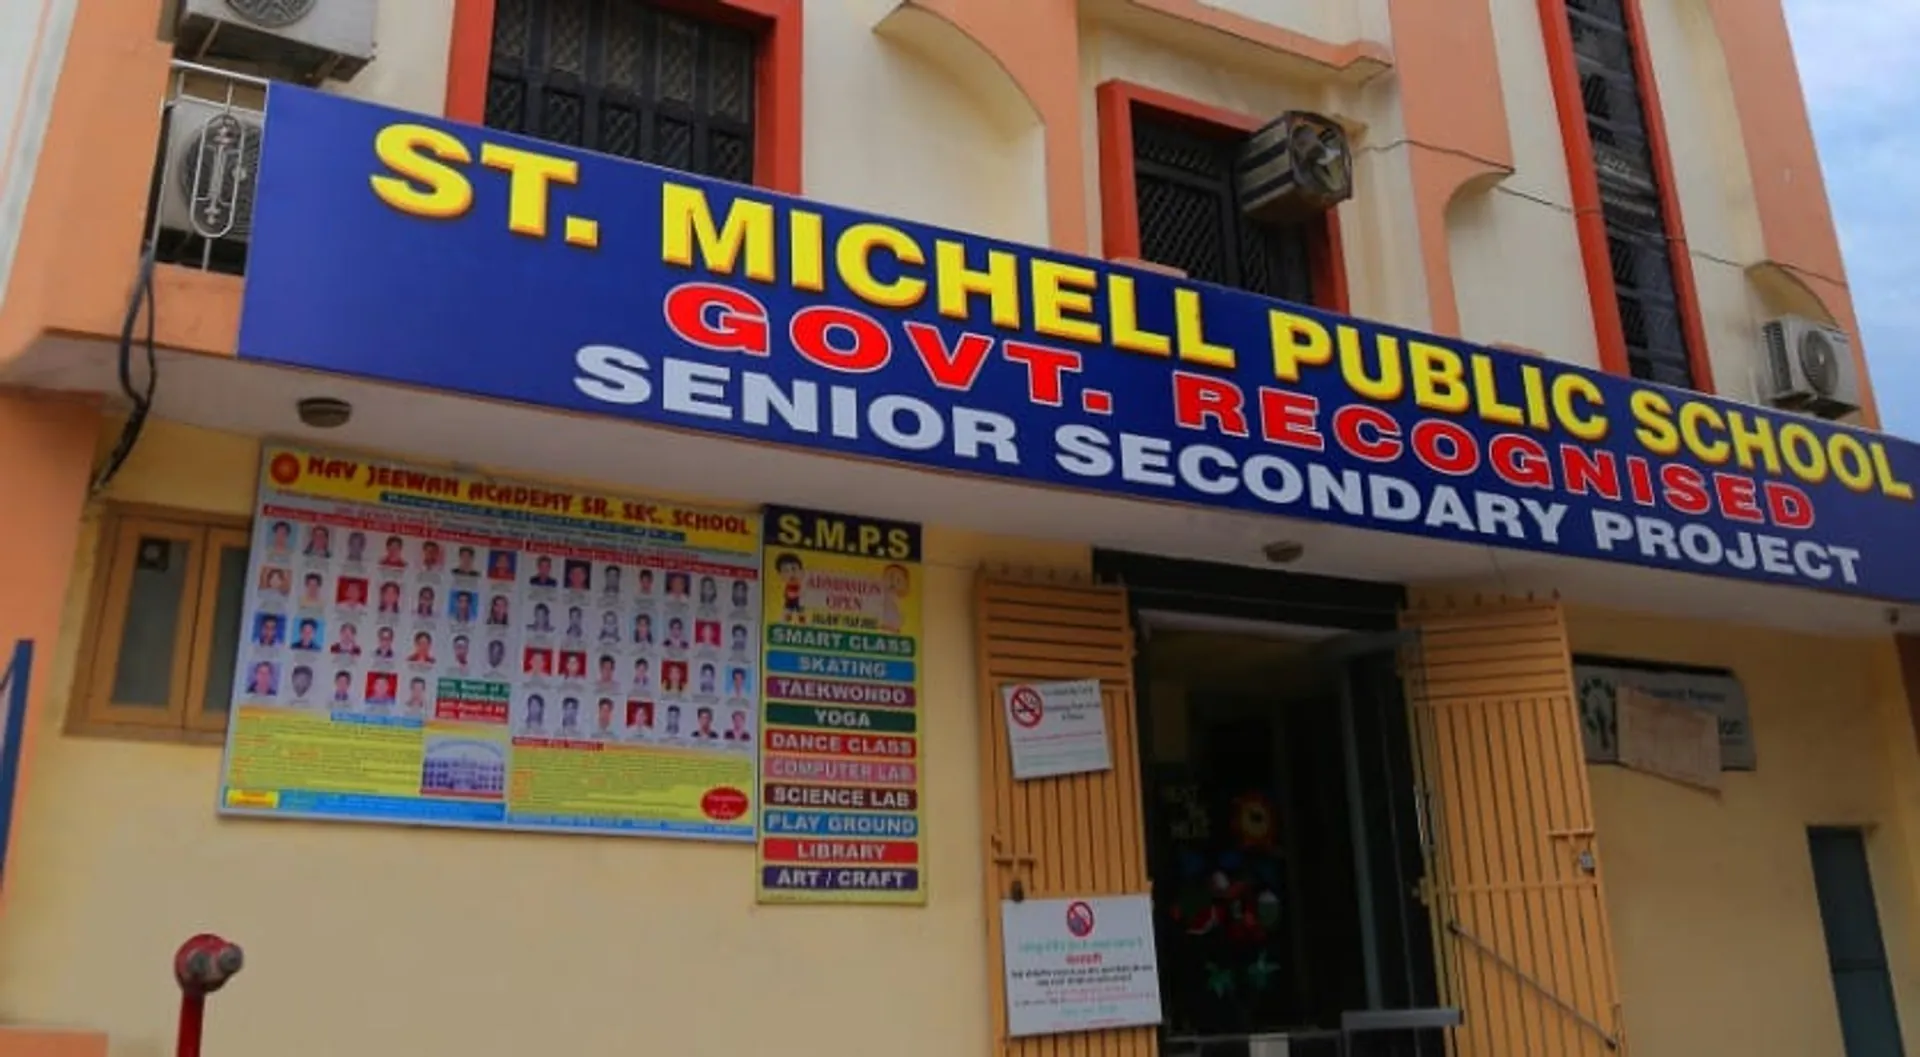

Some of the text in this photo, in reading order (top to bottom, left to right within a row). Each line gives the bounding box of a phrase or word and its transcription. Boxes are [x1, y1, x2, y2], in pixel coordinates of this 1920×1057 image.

[369, 123, 1914, 500] ST. MICHELL PUBLIC SCHOOL
[663, 282, 1816, 529] GOVT. RECOGNISED
[573, 344, 1860, 584] SENIOR SECONDARY PROJECT
[307, 455, 359, 480] NAV
[366, 465, 460, 497] JEEWAN
[468, 481, 573, 513] ACADEMY
[580, 495, 615, 518] SR.
[622, 503, 663, 525] SEC.
[671, 509, 751, 536] SCHOOL
[777, 513, 911, 560] S.M.P.S
[772, 627, 912, 653] SMART CLASS
[799, 655, 888, 678] SKATING
[778, 679, 907, 704] TAEKWONDO
[815, 709, 871, 728] YOGA
[771, 732, 912, 754] DANCE CLASS
[771, 758, 912, 781] COMPUTER LAB
[773, 785, 910, 807] SCIENCE LAB
[767, 811, 823, 830] PLAY
[828, 814, 915, 834] GROUND
[797, 842, 887, 860] LIBRARY
[776, 869, 821, 886] ART
[837, 871, 908, 887] CRAFT
